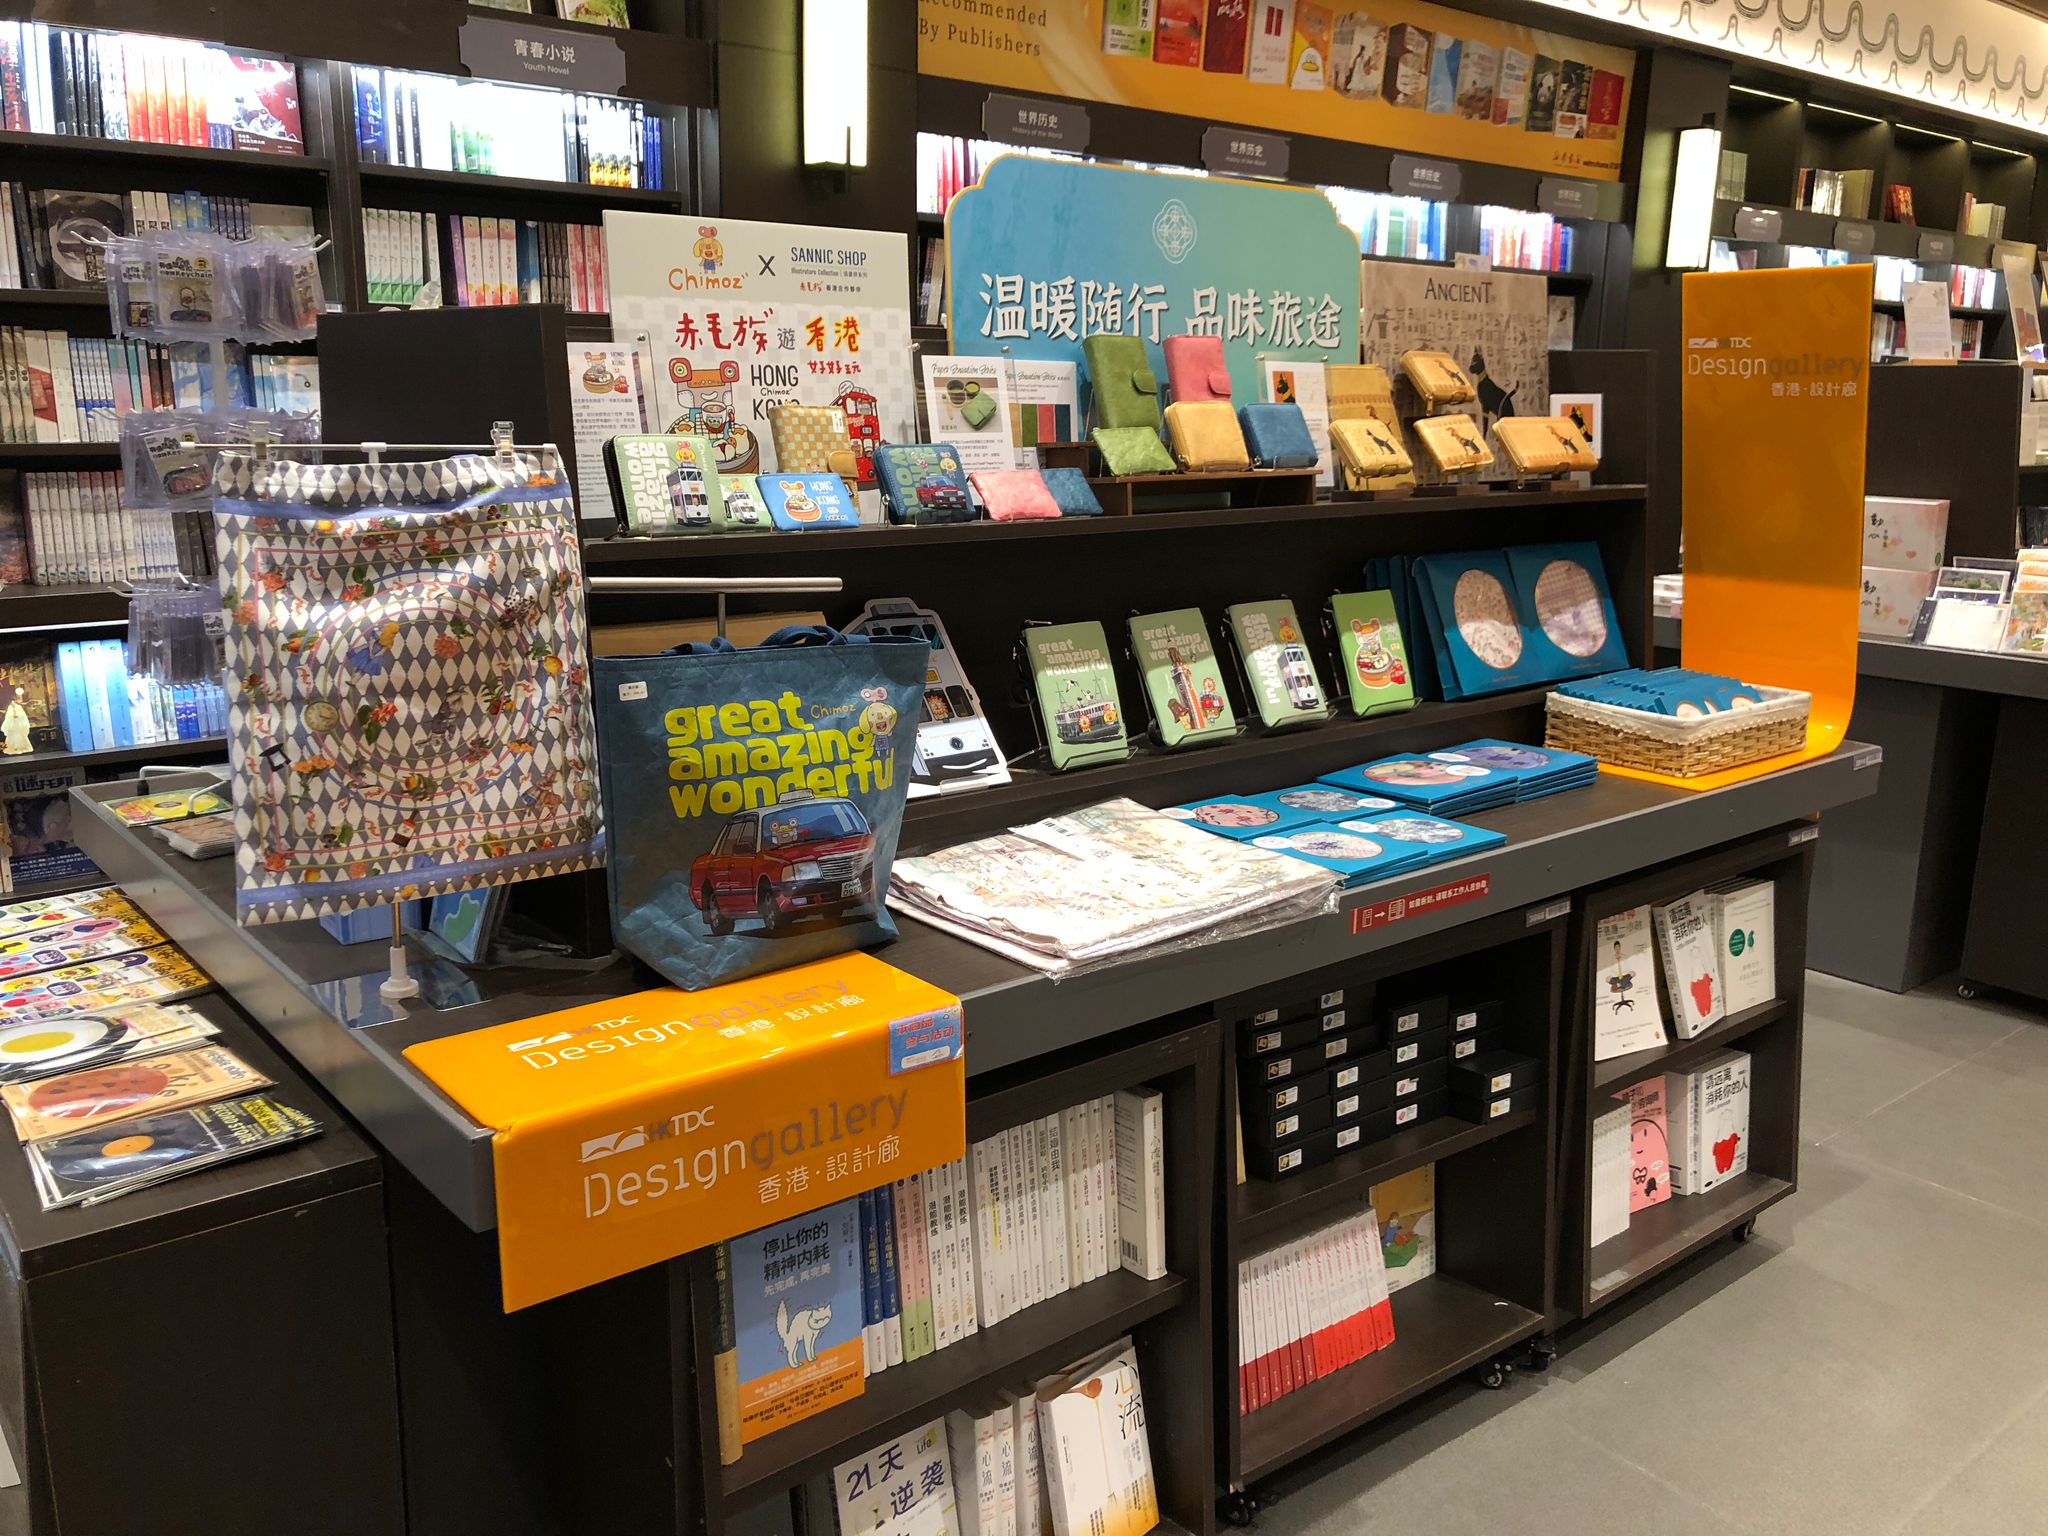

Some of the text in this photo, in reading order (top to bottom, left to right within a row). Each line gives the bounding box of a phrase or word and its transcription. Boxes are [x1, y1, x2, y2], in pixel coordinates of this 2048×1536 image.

[513, 39, 576, 63] 青春小说
[920, 18, 1041, 56] By Publishers
[523, 61, 569, 75] Youth Novel
[1018, 110, 1058, 129] 世界历史
[1230, 140, 1264, 158] 世界历史
[791, 247, 833, 265] SANNIC
[837, 250, 867, 266] SHOP
[1424, 277, 1493, 305] ANCIENT
[978, 272, 1343, 349] 温暖随行 品味旅途
[777, 327, 796, 350] 遊
[805, 316, 861, 352] 香港
[751, 364, 798, 387] HONG
[760, 387, 791, 397] Chimoz
[810, 481, 834, 492] HONG
[816, 495, 840, 505] KONG
[1038, 639, 1073, 654] great
[1143, 624, 1176, 641] great
[1151, 632, 1201, 650] amazing
[1045, 657, 1109, 675] wonderful
[1047, 649, 1100, 665] amazing
[664, 691, 815, 747] great
[810, 702, 857, 720] Chimoz
[667, 726, 875, 781] amazing
[668, 747, 895, 819] wonderful
[1705, 1067, 1732, 1090] 请远离
[1706, 1077, 1748, 1106] 消耗你的人
[583, 1089, 907, 1218] Designgallery
[1049, 1127, 1060, 1172] 结婚由我
[928, 1200, 938, 1238] 潜能教练
[943, 1194, 953, 1231] 潜能教练
[958, 1189, 968, 1225] 潜能教练
[763, 1221, 829, 1260] 停止你的
[764, 1243, 830, 1282] 精神内耗
[1115, 1360, 1145, 1440] 心流
[916, 1438, 932, 1455] Life
[1001, 1442, 1012, 1477] 心流
[1028, 1428, 1039, 1463] 心流
[846, 1443, 904, 1502] 21天
[982, 1450, 992, 1485] 心流
[891, 1459, 945, 1519] 逆袭
